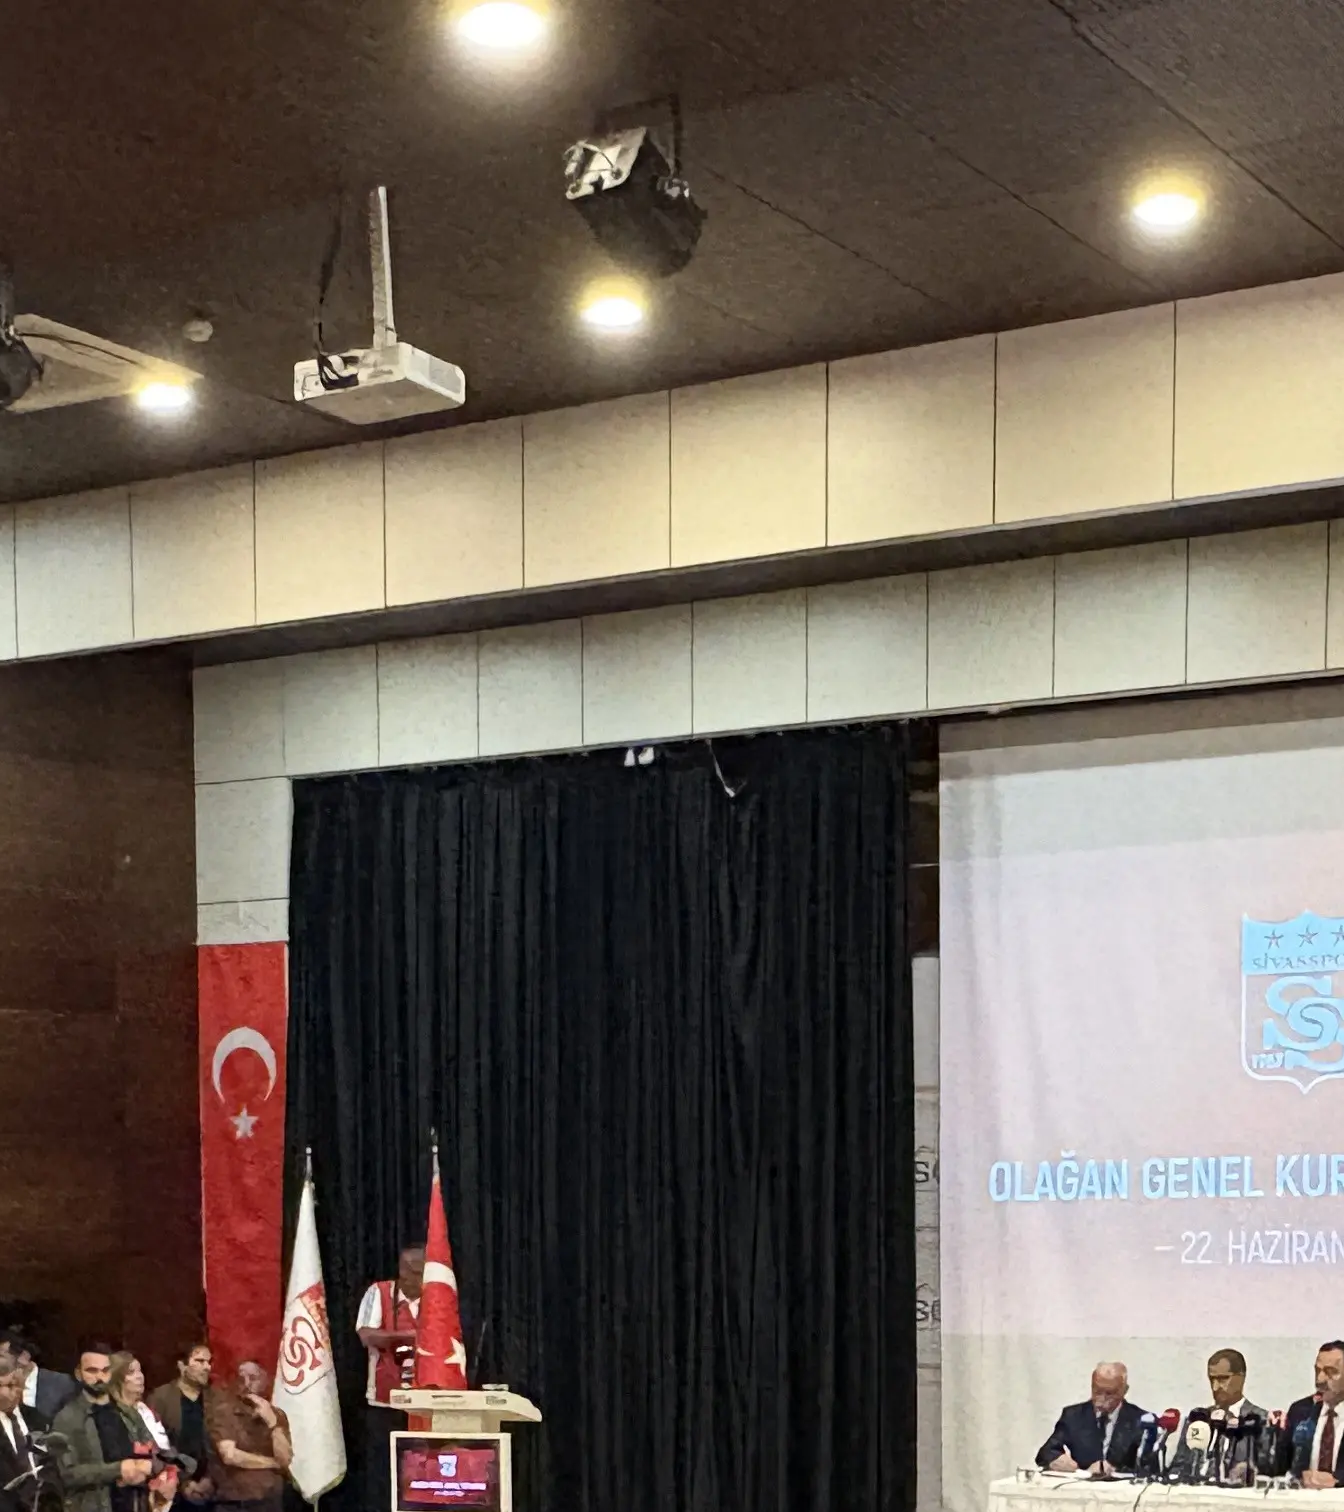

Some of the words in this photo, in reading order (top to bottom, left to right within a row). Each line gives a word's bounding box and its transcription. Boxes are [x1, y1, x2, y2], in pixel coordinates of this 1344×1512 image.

[988, 1149, 1128, 1202] OLAĞAN
[1142, 1156, 1264, 1199] GENEL
[1181, 1230, 1218, 1264] 22
